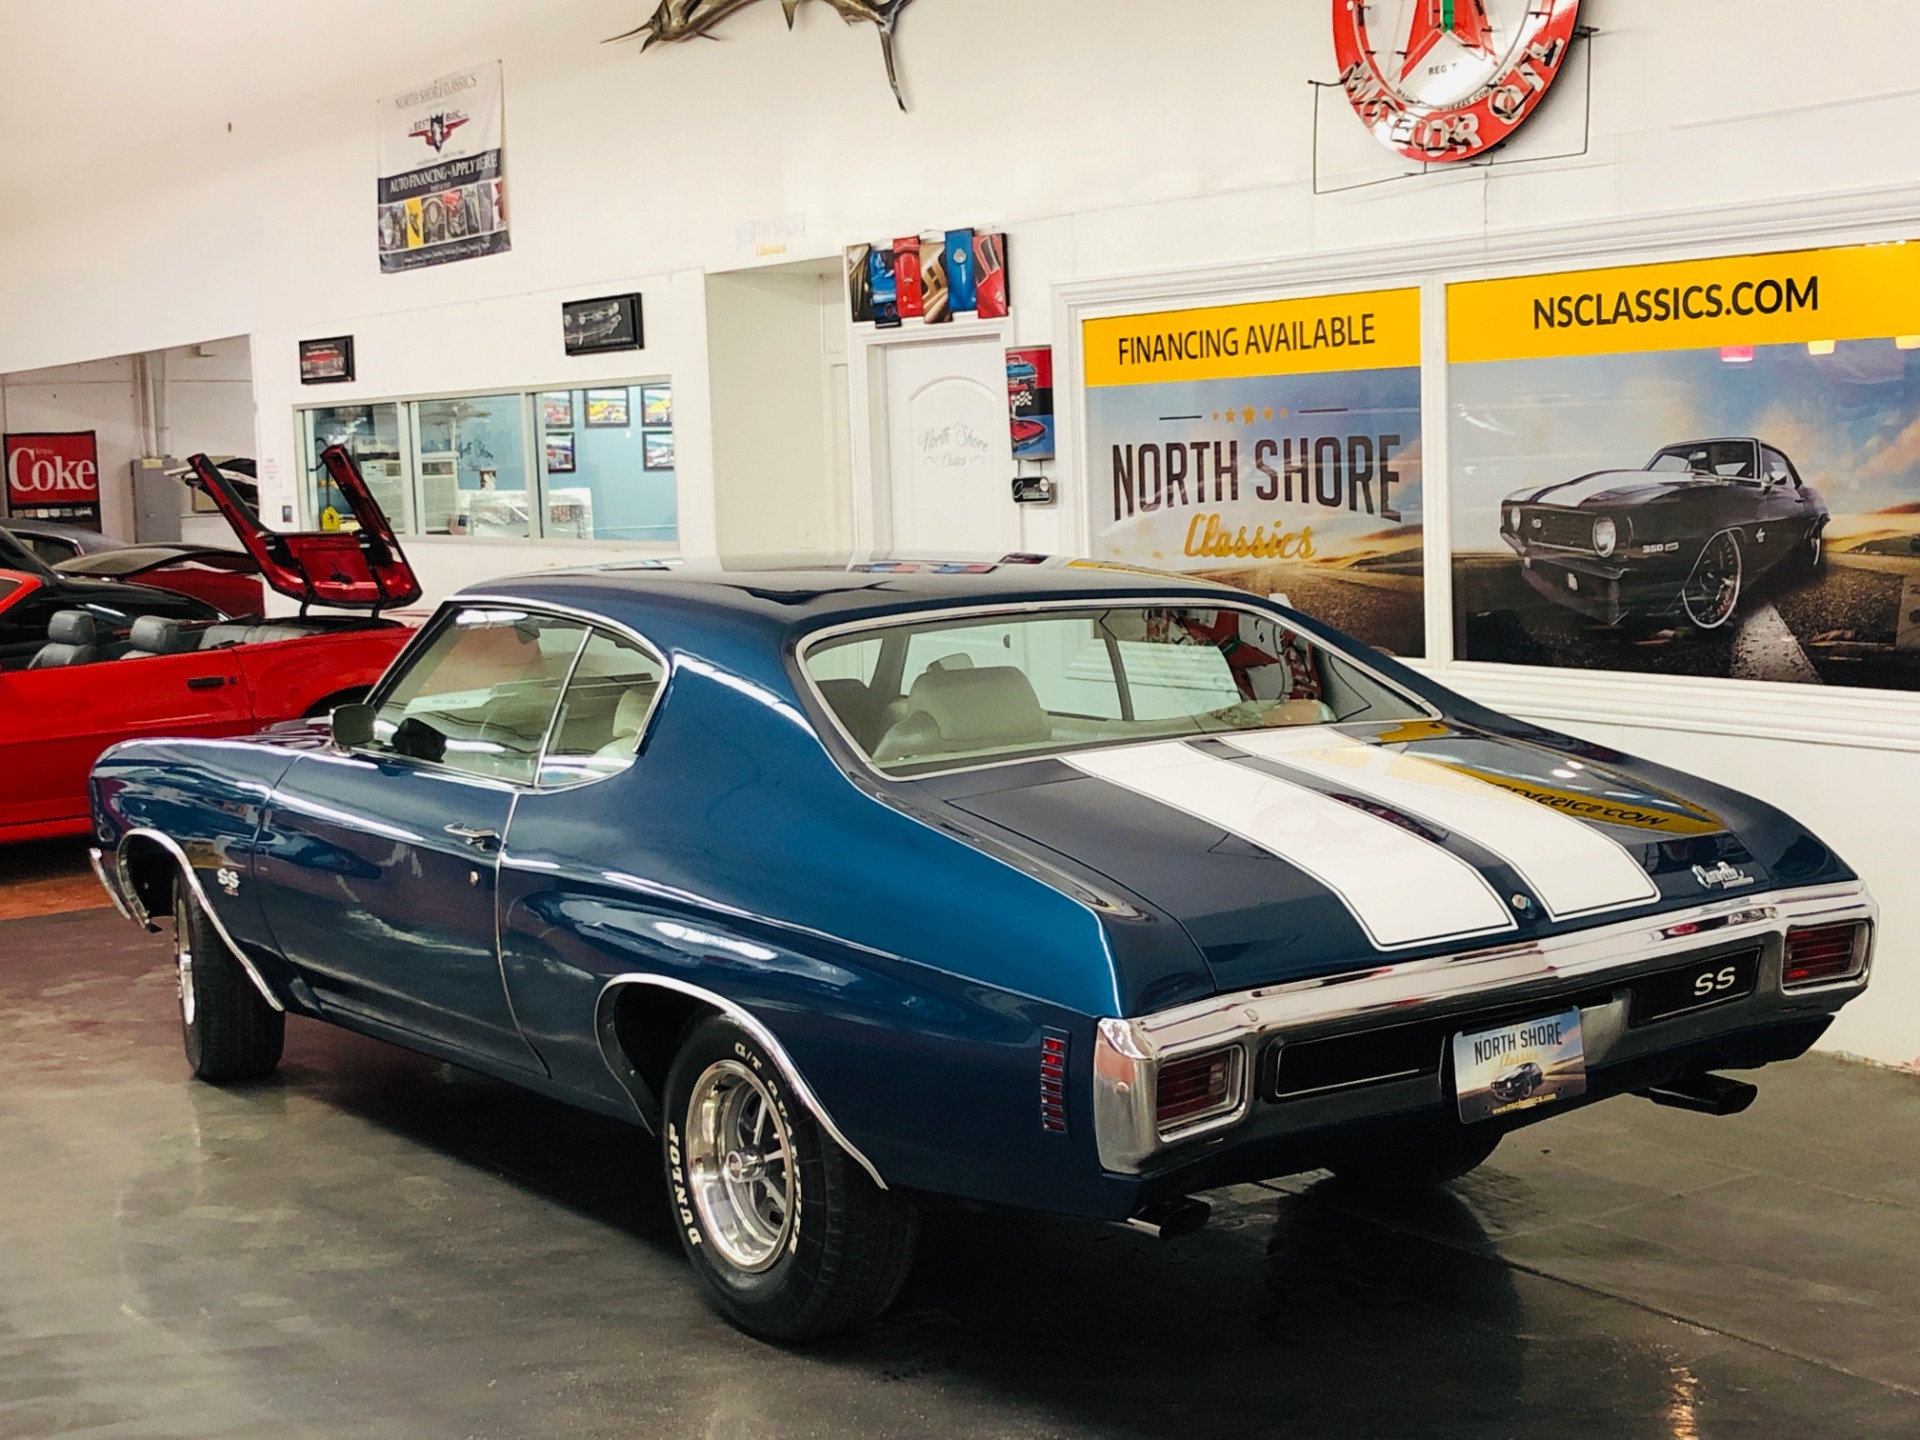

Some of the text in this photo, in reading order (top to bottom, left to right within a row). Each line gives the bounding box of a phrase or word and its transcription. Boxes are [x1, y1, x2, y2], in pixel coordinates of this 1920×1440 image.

[1428, 64, 1447, 76] REG
[410, 166, 447, 188] FINANCING
[451, 158, 476, 177] APPLY
[476, 154, 498, 171] HERE
[1533, 276, 1819, 330] NSCLASSICS.COM
[1118, 313, 1376, 366] FINANCING AVAILABLE
[953, 422, 990, 453] Shore
[9, 447, 97, 492] Coke
[1112, 434, 1402, 523] NORTH SHORE
[1184, 512, 1318, 560] Classics
[217, 867, 241, 889] SS
[1694, 965, 1736, 997] SS
[1473, 1022, 1563, 1066] NORTH SHORE
[669, 1122, 703, 1247] DUNLOP
